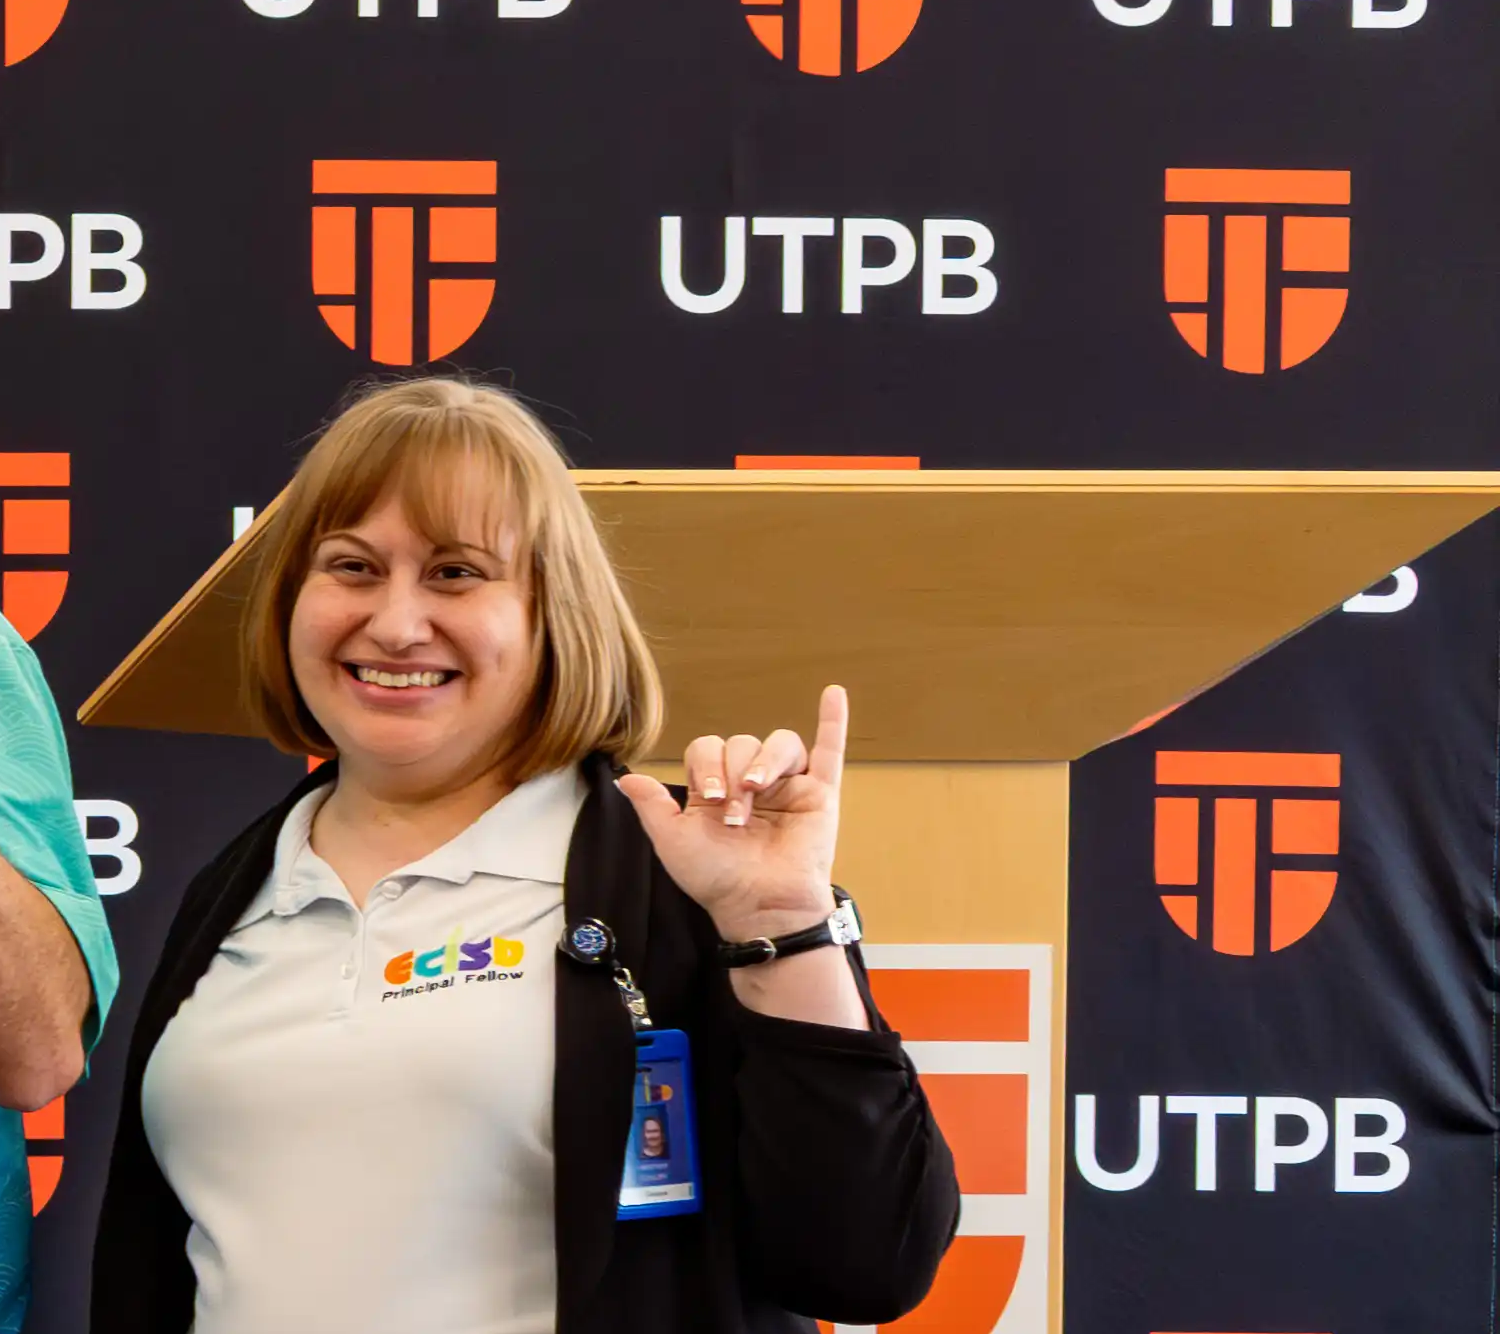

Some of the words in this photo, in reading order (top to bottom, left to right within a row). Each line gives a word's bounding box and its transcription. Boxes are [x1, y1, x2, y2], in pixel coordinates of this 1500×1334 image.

[660, 215, 998, 315] UTPB
[381, 977, 455, 1003] Principal
[465, 970, 525, 984] Fellow
[1074, 1094, 1411, 1193] UTPB
